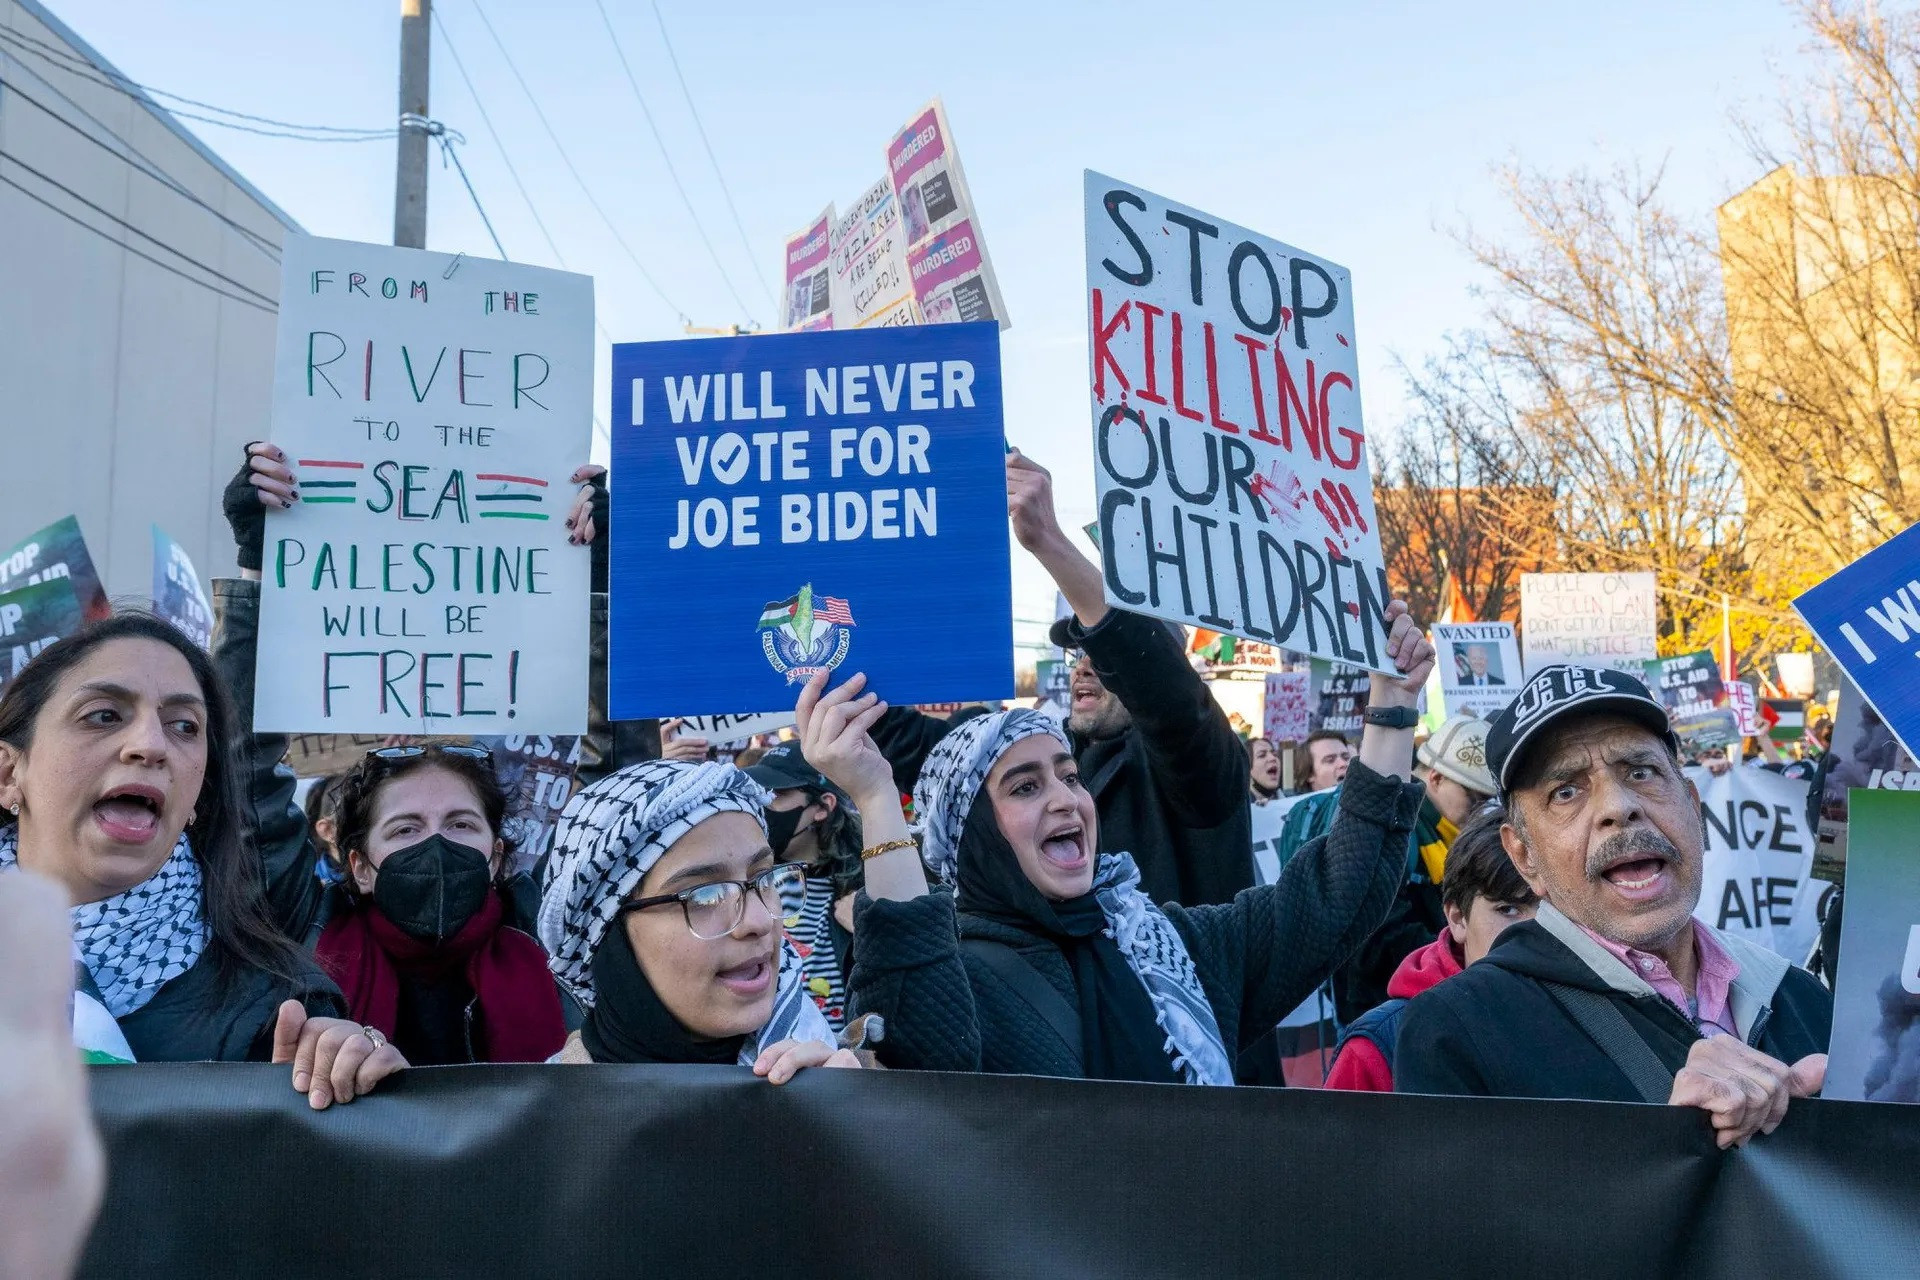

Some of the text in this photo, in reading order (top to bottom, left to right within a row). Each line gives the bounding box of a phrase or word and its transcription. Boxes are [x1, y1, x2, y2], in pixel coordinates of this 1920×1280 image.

[893, 125, 936, 173] MURDERED
[912, 236, 971, 280] MURDERED
[1101, 189, 1339, 350] STOP
[311, 270, 540, 316] FROM THE
[307, 331, 550, 411] RIVER
[632, 360, 975, 425] I WILL NEVER
[1093, 288, 1366, 470] KILLING
[353, 417, 495, 447] TO THE
[676, 424, 931, 486] VOTE FOR
[1099, 403, 1270, 523] OUR
[367, 460, 469, 523] SEA
[668, 487, 937, 550] JOE BIDEN
[0, 543, 39, 583] TOP
[276, 538, 552, 595] PALESTINE
[1100, 489, 1391, 669] CHILDREN
[1527, 574, 1629, 595] PEOPLE ON
[323, 605, 487, 637] WILL BE
[1540, 595, 1603, 618] STOLEN
[763, 629, 849, 672] PALESTINIAN AMERICAN
[1439, 626, 1511, 640] WANTED
[1530, 637, 1560, 650] WHAT
[1562, 635, 1633, 656] JUSTICE
[323, 649, 520, 718] FREE!
[1660, 668, 1709, 688] U.S. AID
[1662, 656, 1695, 672] STOP
[1322, 678, 1348, 694] U.S.
[1338, 698, 1355, 712] TO
[1679, 686, 1697, 700] TO
[533, 771, 571, 810] TO
